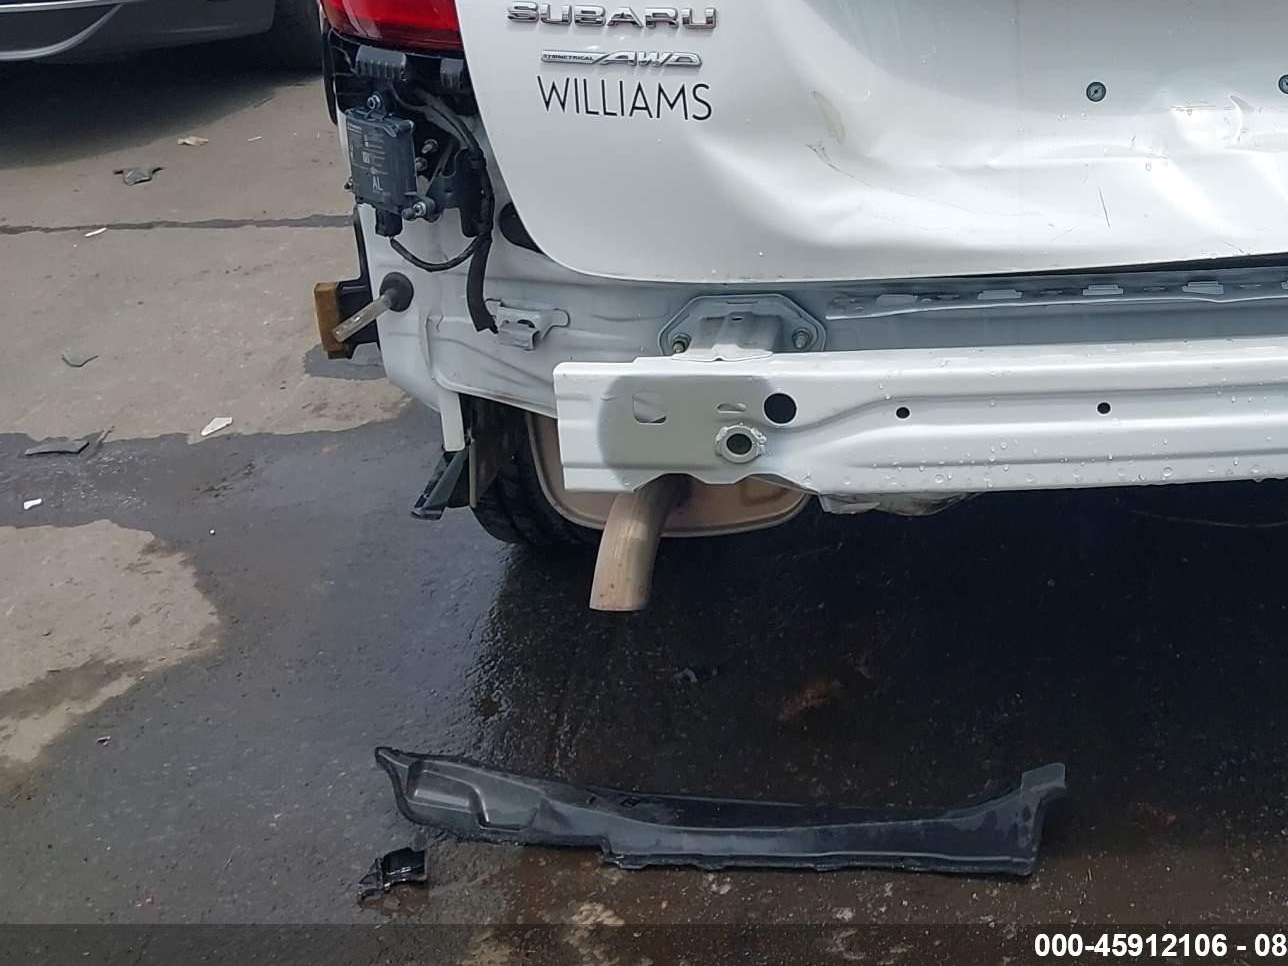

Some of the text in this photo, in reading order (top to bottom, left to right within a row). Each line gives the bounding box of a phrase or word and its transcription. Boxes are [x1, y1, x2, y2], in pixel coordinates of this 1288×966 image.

[507, 0, 717, 30] SUBARU
[600, 50, 702, 68] AWD
[537, 75, 712, 121] WILLIAMS
